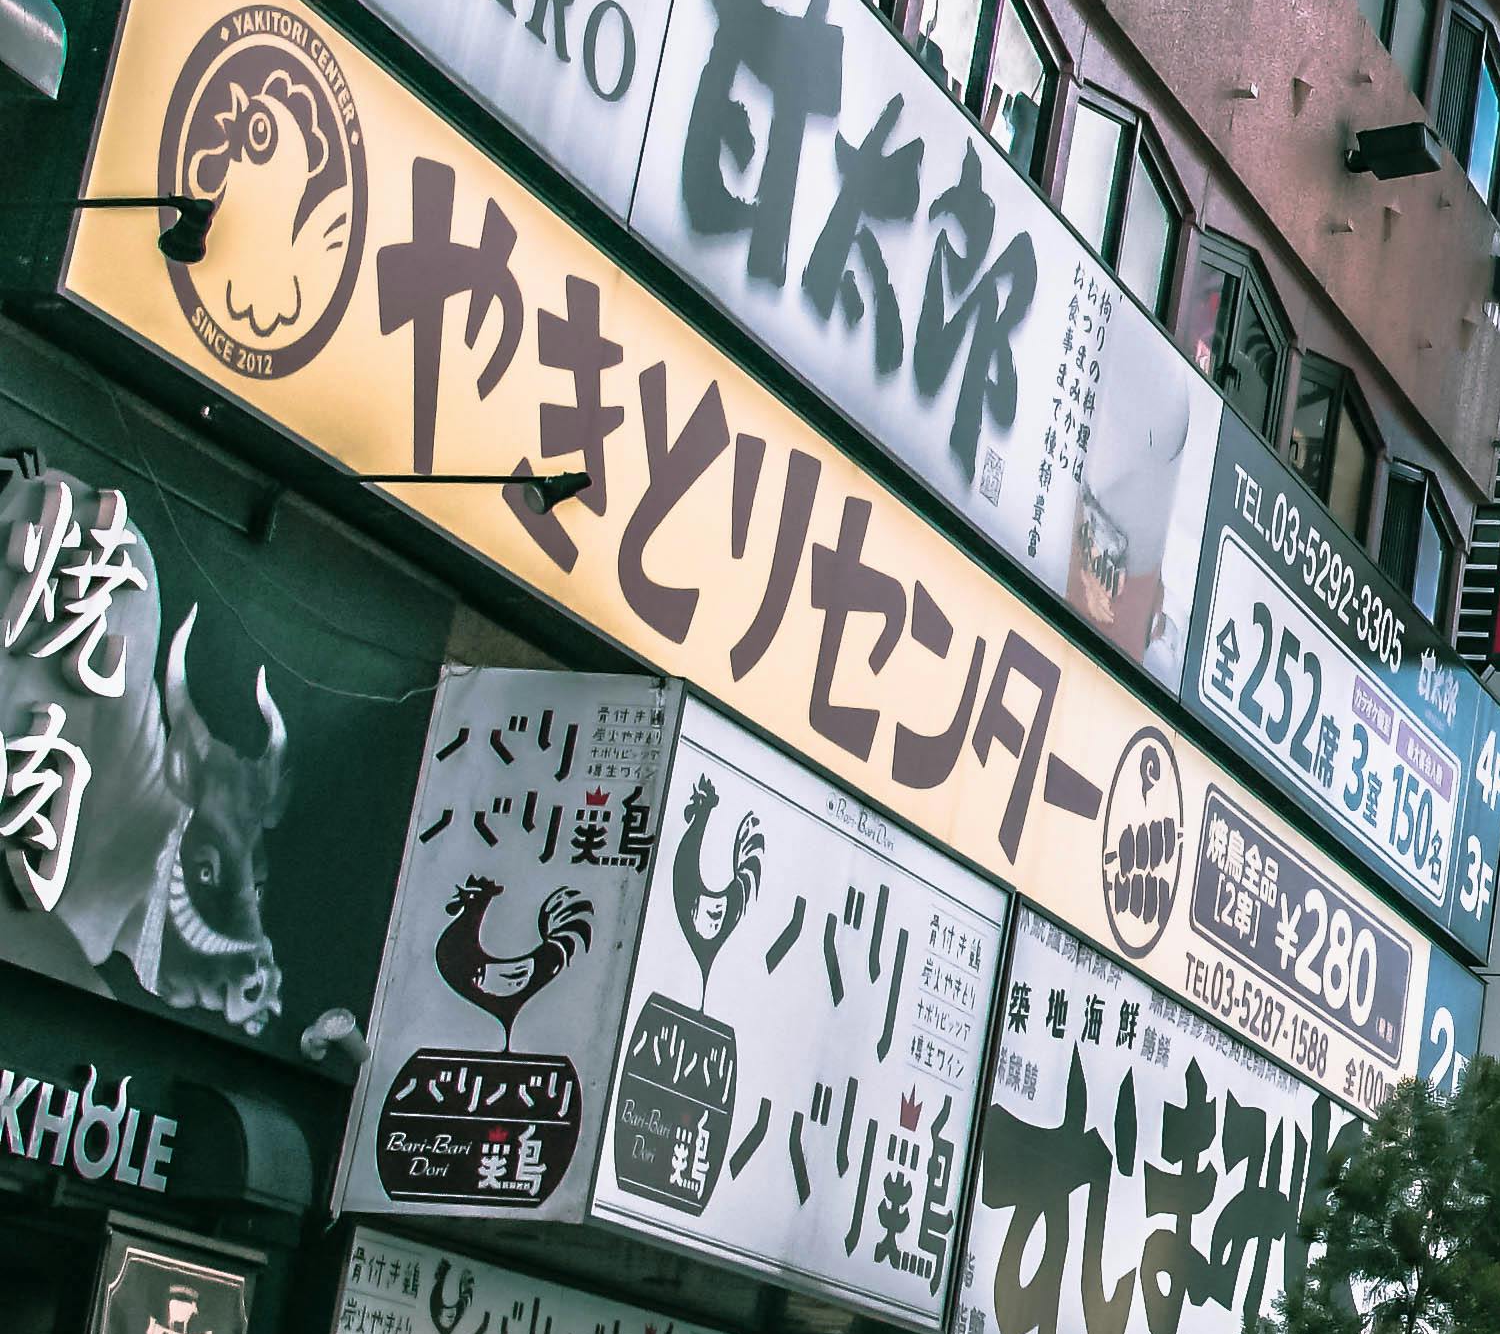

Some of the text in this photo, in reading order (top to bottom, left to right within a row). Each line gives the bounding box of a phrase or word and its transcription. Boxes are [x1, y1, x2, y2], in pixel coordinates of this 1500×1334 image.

[232, 10, 358, 124] YAKITORI CENTER
[191, 306, 273, 375] SINCE 2012
[376, 156, 1102, 866] やきとりセンター
[1234, 462, 1405, 675] TEL.03-5292-3305
[2, 481, 148, 912] 焼肉
[435, 709, 579, 783] バリ
[1459, 834, 1494, 922] 3F
[765, 883, 909, 1064] バリ
[1274, 888, 1378, 1027] ¥280
[1007, 981, 1141, 1051] 築地海鮮
[395, 1067, 573, 1118] バリバリ
[627, 1024, 734, 1115] バリバリ
[386, 1131, 470, 1158] Bari-Bari
[409, 1157, 449, 1179] Dori
